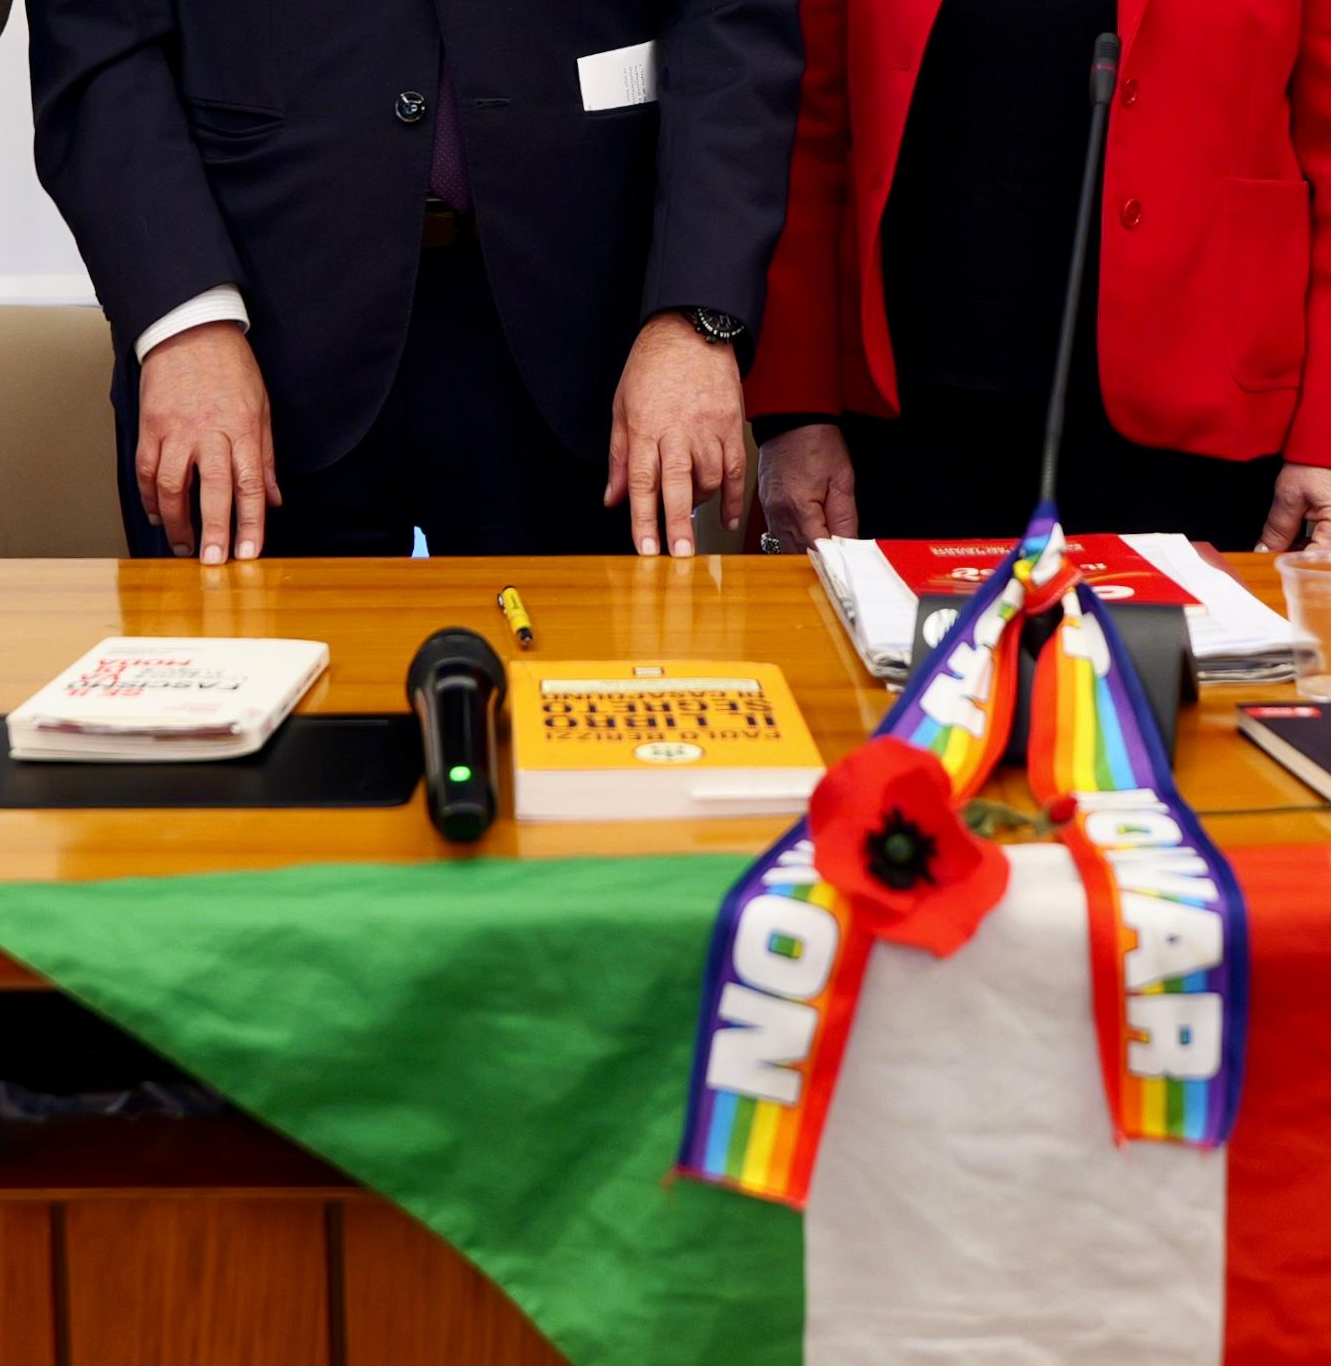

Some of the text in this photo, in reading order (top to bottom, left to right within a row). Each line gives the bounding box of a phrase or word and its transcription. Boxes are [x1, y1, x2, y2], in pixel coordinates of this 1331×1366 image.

[541, 697, 774, 714] SEGRETO
[543, 712, 776, 730] IL LIBRO
[544, 729, 782, 742] PAOLO BERIZZI
[1099, 844, 1225, 1082] WAR
[705, 894, 840, 1105] NO
